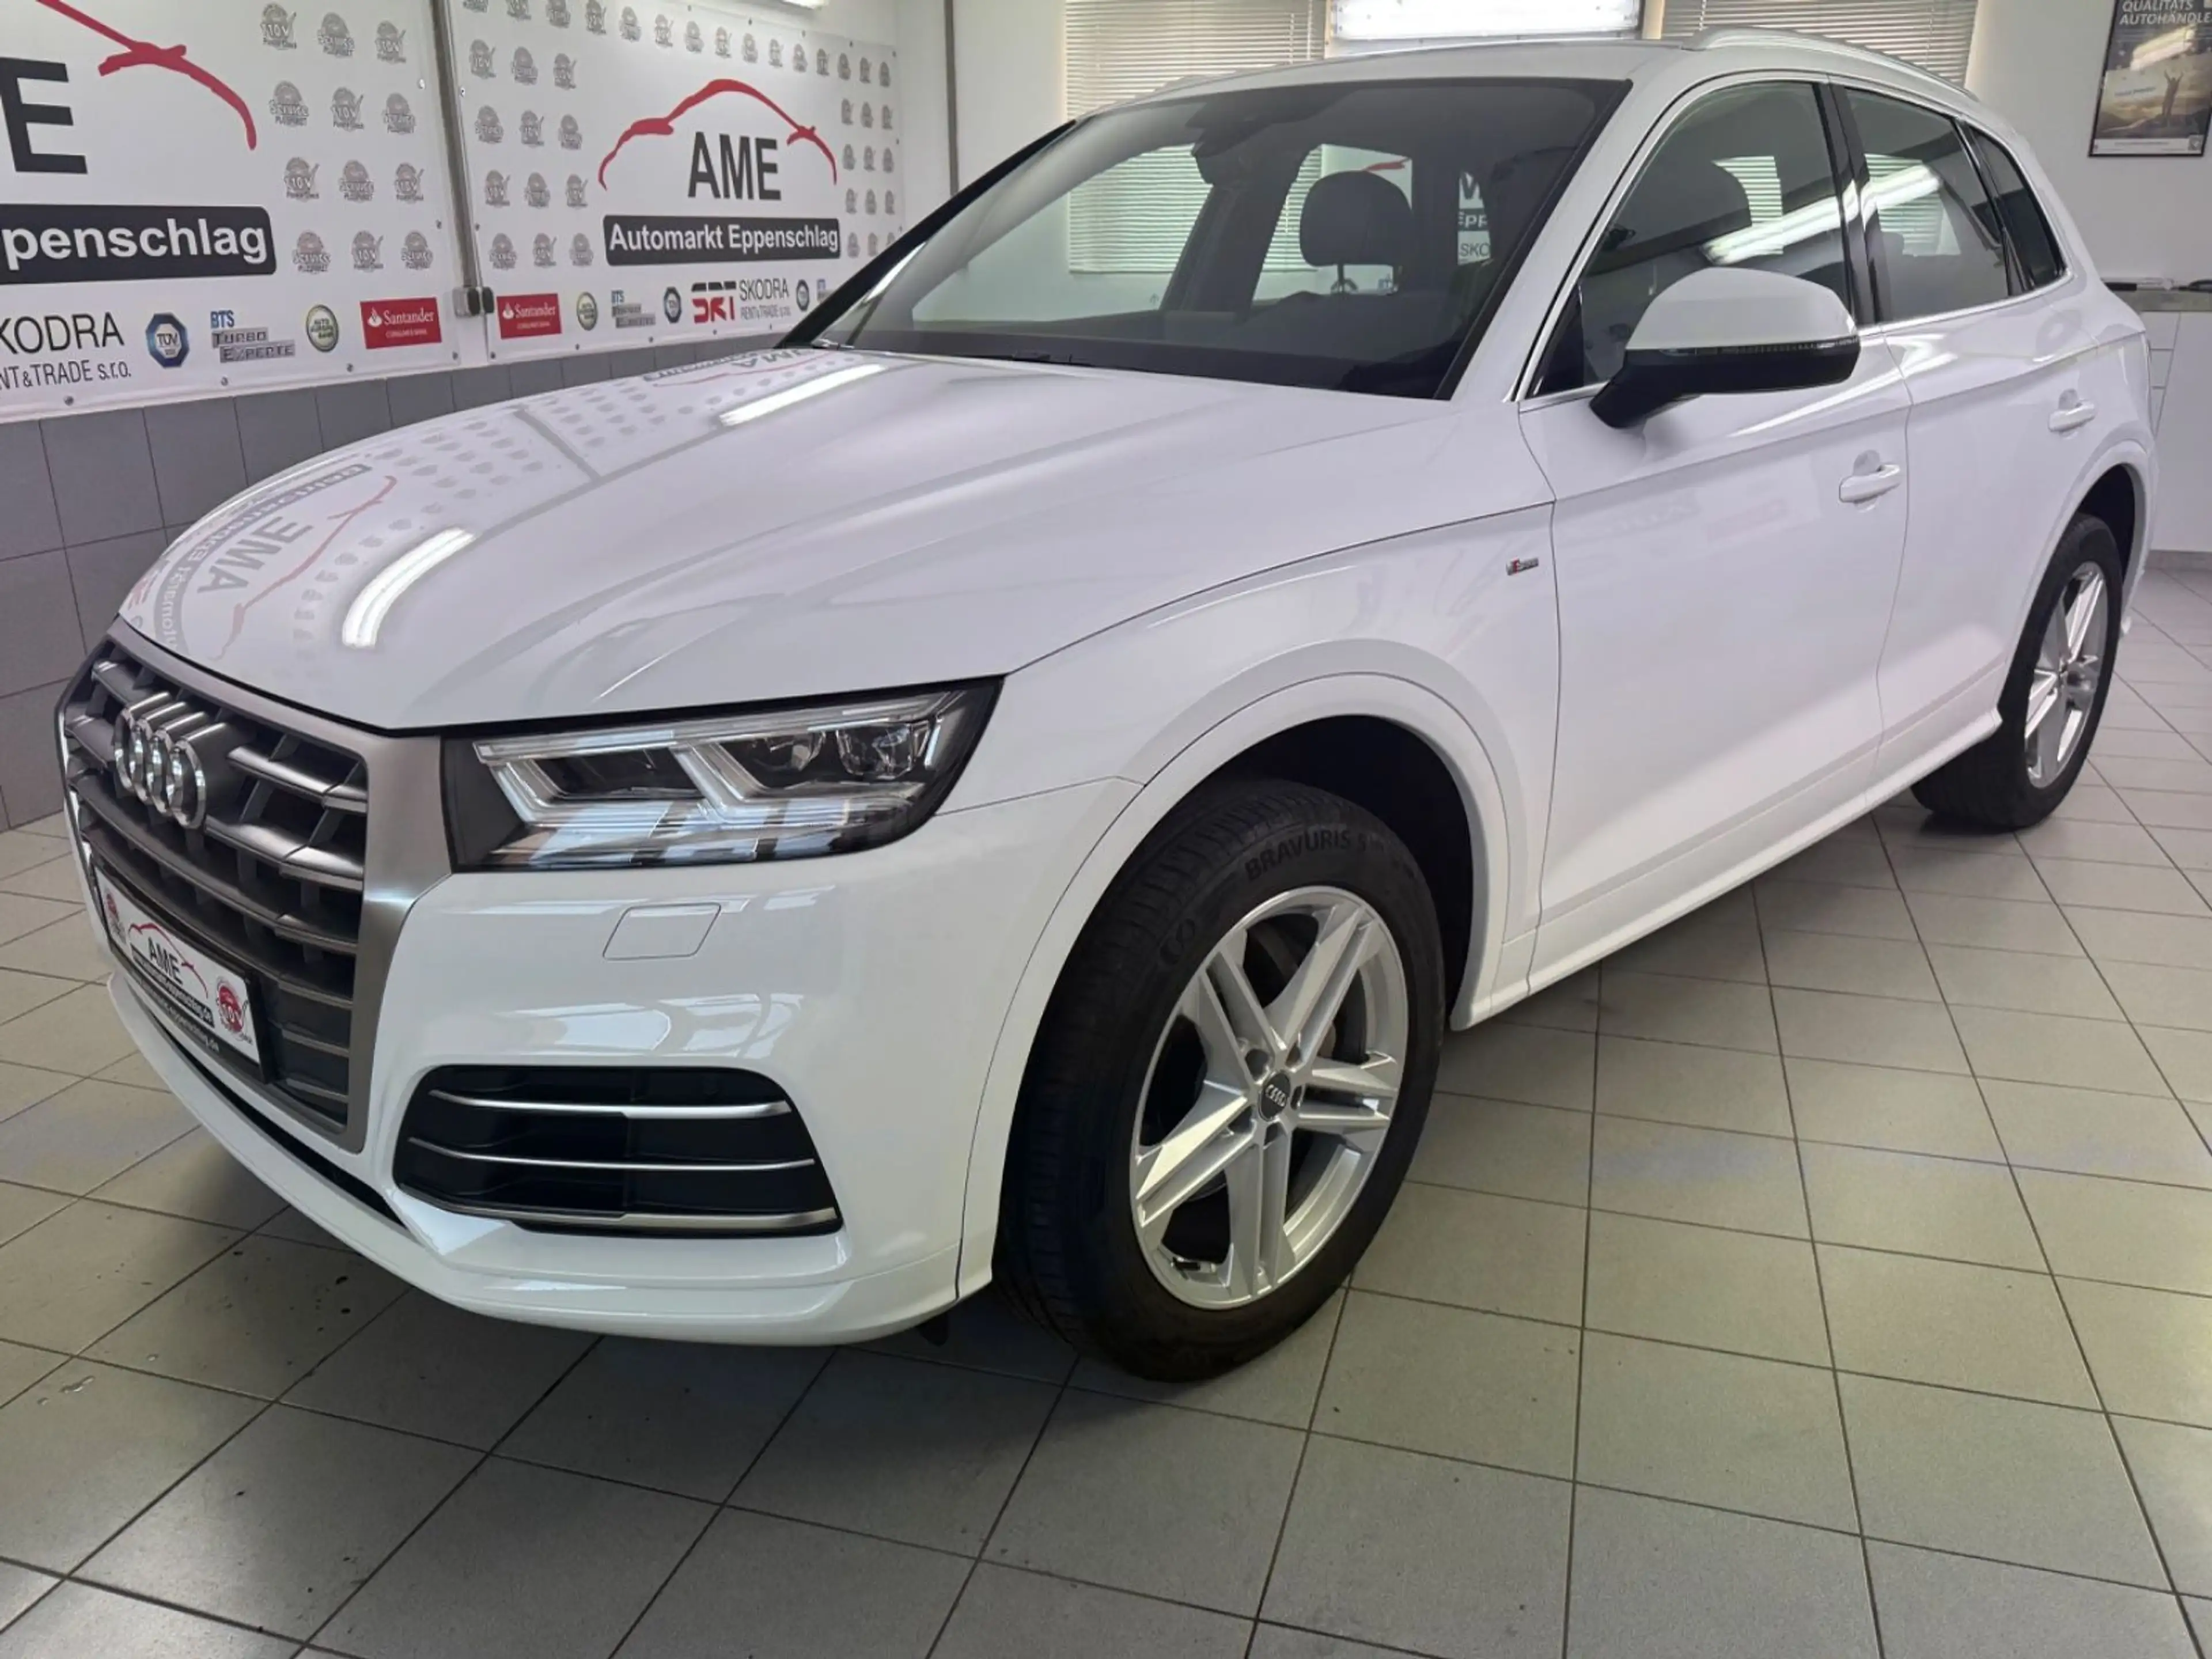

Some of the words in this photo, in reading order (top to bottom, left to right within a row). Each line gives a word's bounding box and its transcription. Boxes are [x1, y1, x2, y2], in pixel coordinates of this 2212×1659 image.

[688, 131, 782, 200] AME
[609, 223, 724, 251] Automarkt
[728, 224, 839, 254] Eppenschlag
[739, 278, 790, 301] SKODRA
[210, 309, 234, 329] BTS
[383, 307, 434, 325] Santander
[514, 302, 556, 319] Santander
[1245, 830, 1351, 881] BRAVURIS
[148, 937, 183, 986] AME
